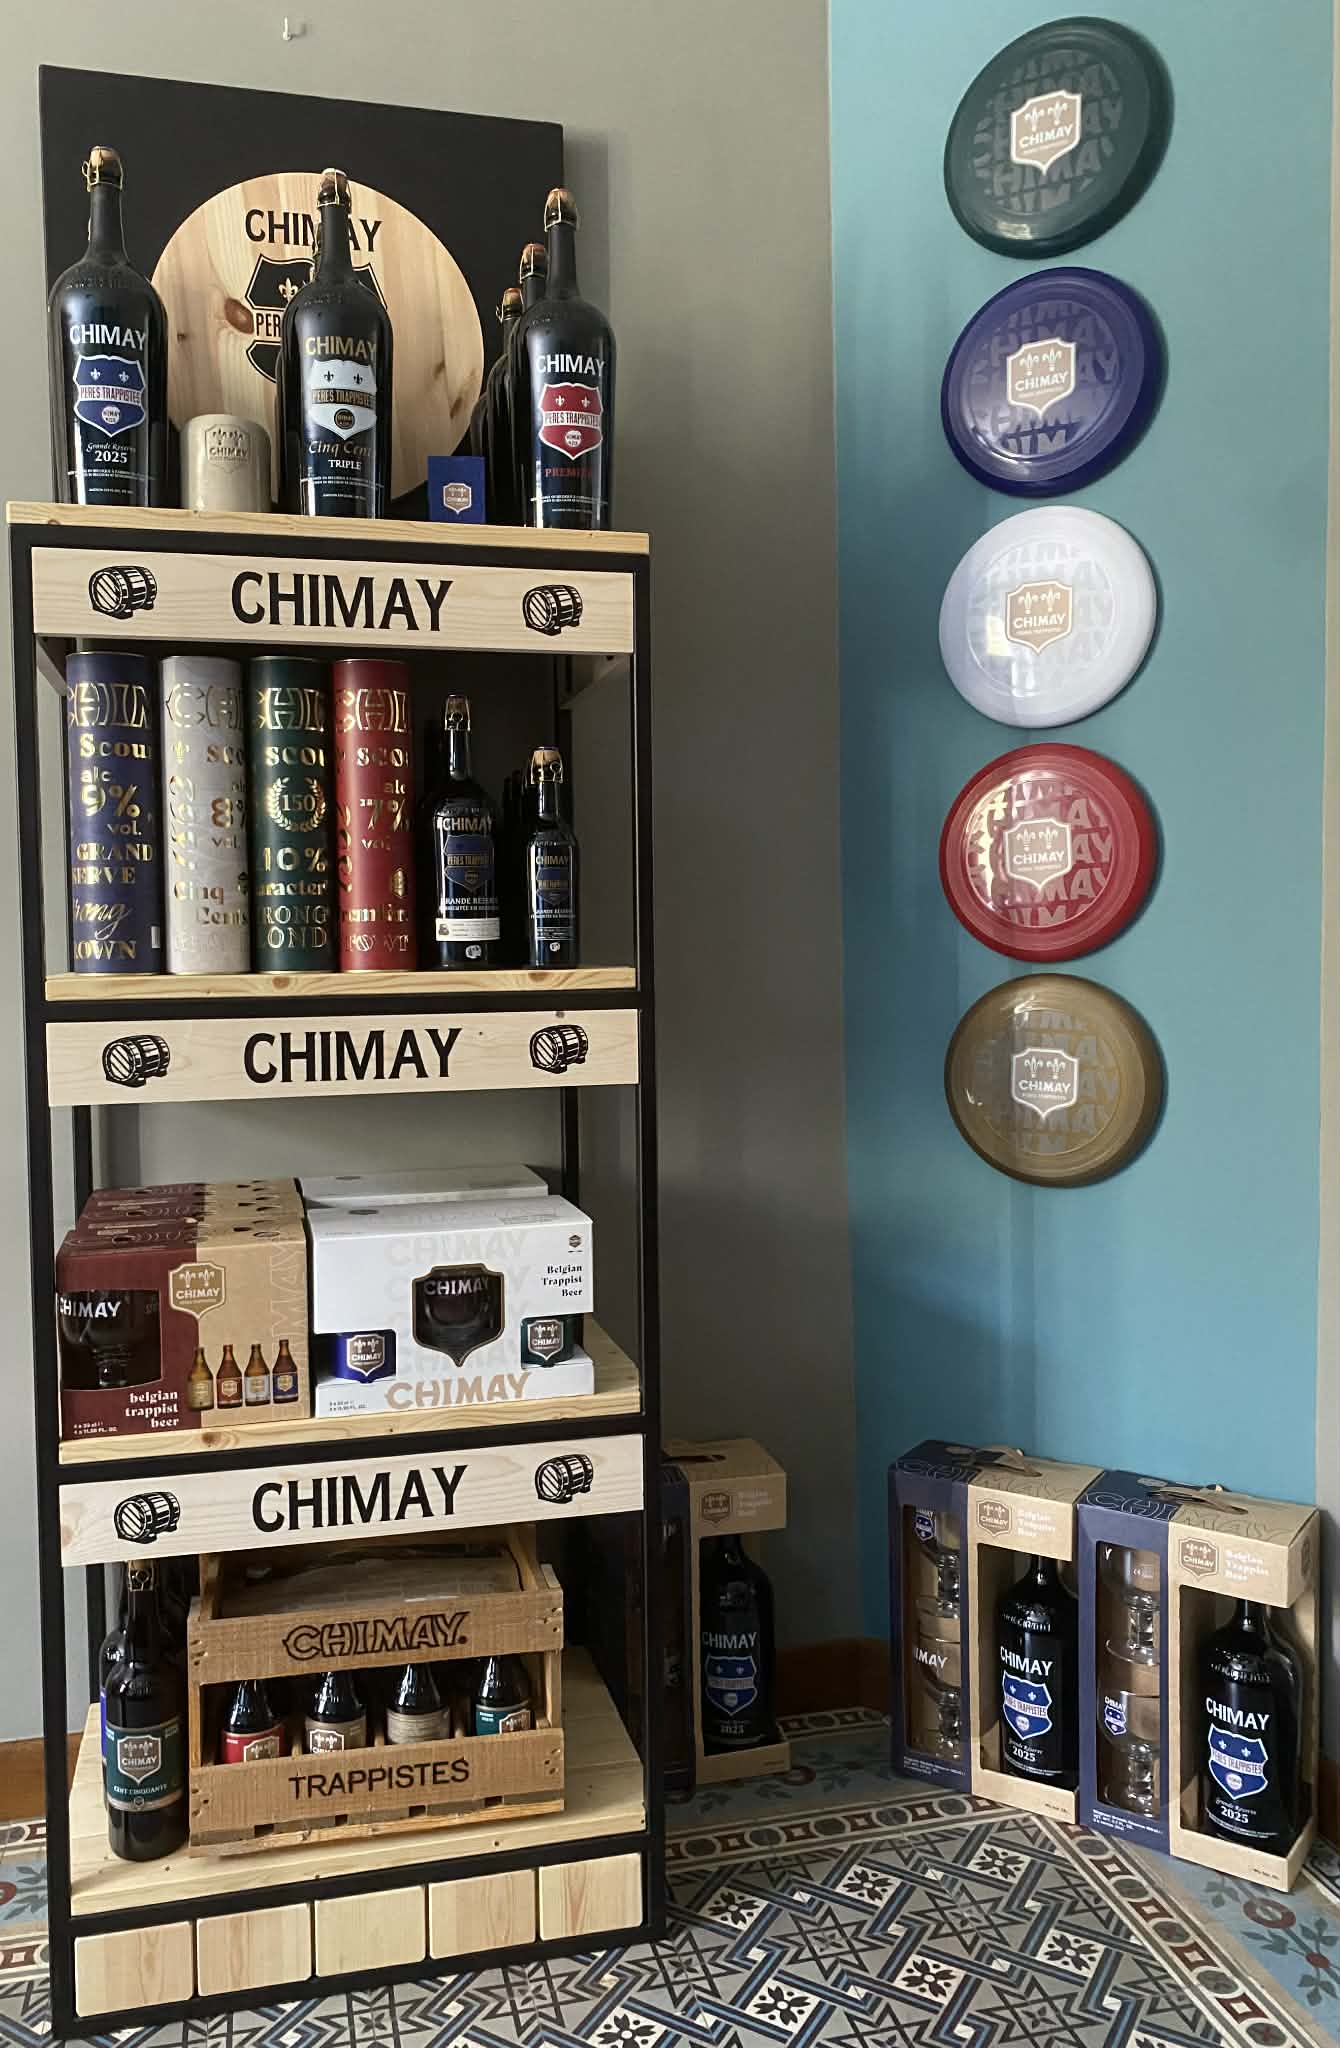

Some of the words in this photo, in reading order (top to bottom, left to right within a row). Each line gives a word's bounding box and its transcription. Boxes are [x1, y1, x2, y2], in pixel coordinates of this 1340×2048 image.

[1019, 125, 1073, 148] CHIMAY
[69, 324, 146, 351] CHIMAY
[305, 335, 377, 361] CHIMAY
[536, 353, 605, 377] CHIMAY
[1015, 371, 1069, 392] CHIMAY
[94, 451, 128, 464] 2025
[308, 440, 340, 457] Cinq
[328, 459, 362, 471] TRIPLE
[232, 571, 454, 632] CHIMAY
[1013, 612, 1066, 630] CHIMAY
[281, 794, 317, 812] 150
[1013, 850, 1065, 866] CHIMAY
[243, 1027, 463, 1084] CHIMAY
[1018, 1079, 1072, 1094] CHIMAY
[547, 1264, 582, 1275] Belgian
[423, 1276, 489, 1296] CHIMAY
[541, 1276, 582, 1287] Trappist
[176, 1288, 220, 1300] CHIMAY
[562, 1289, 582, 1297] Beer
[352, 1353, 382, 1361] CHIMAY
[130, 1390, 178, 1404] belgian
[384, 1372, 532, 1411] CHIMAY
[125, 1403, 179, 1418] trappist
[151, 1418, 180, 1428] beer
[252, 1465, 469, 1532] CHIMAY
[702, 1631, 758, 1649] CHIMAY
[1000, 1646, 1053, 1677] CHIMAY
[1206, 1697, 1270, 1731] CHIMAY
[122, 1755, 157, 1766] CHIMAY
[1012, 1746, 1036, 1762] 2025
[288, 1757, 470, 1801] TRAPPISTES
[1221, 1806, 1249, 1824] 2025
